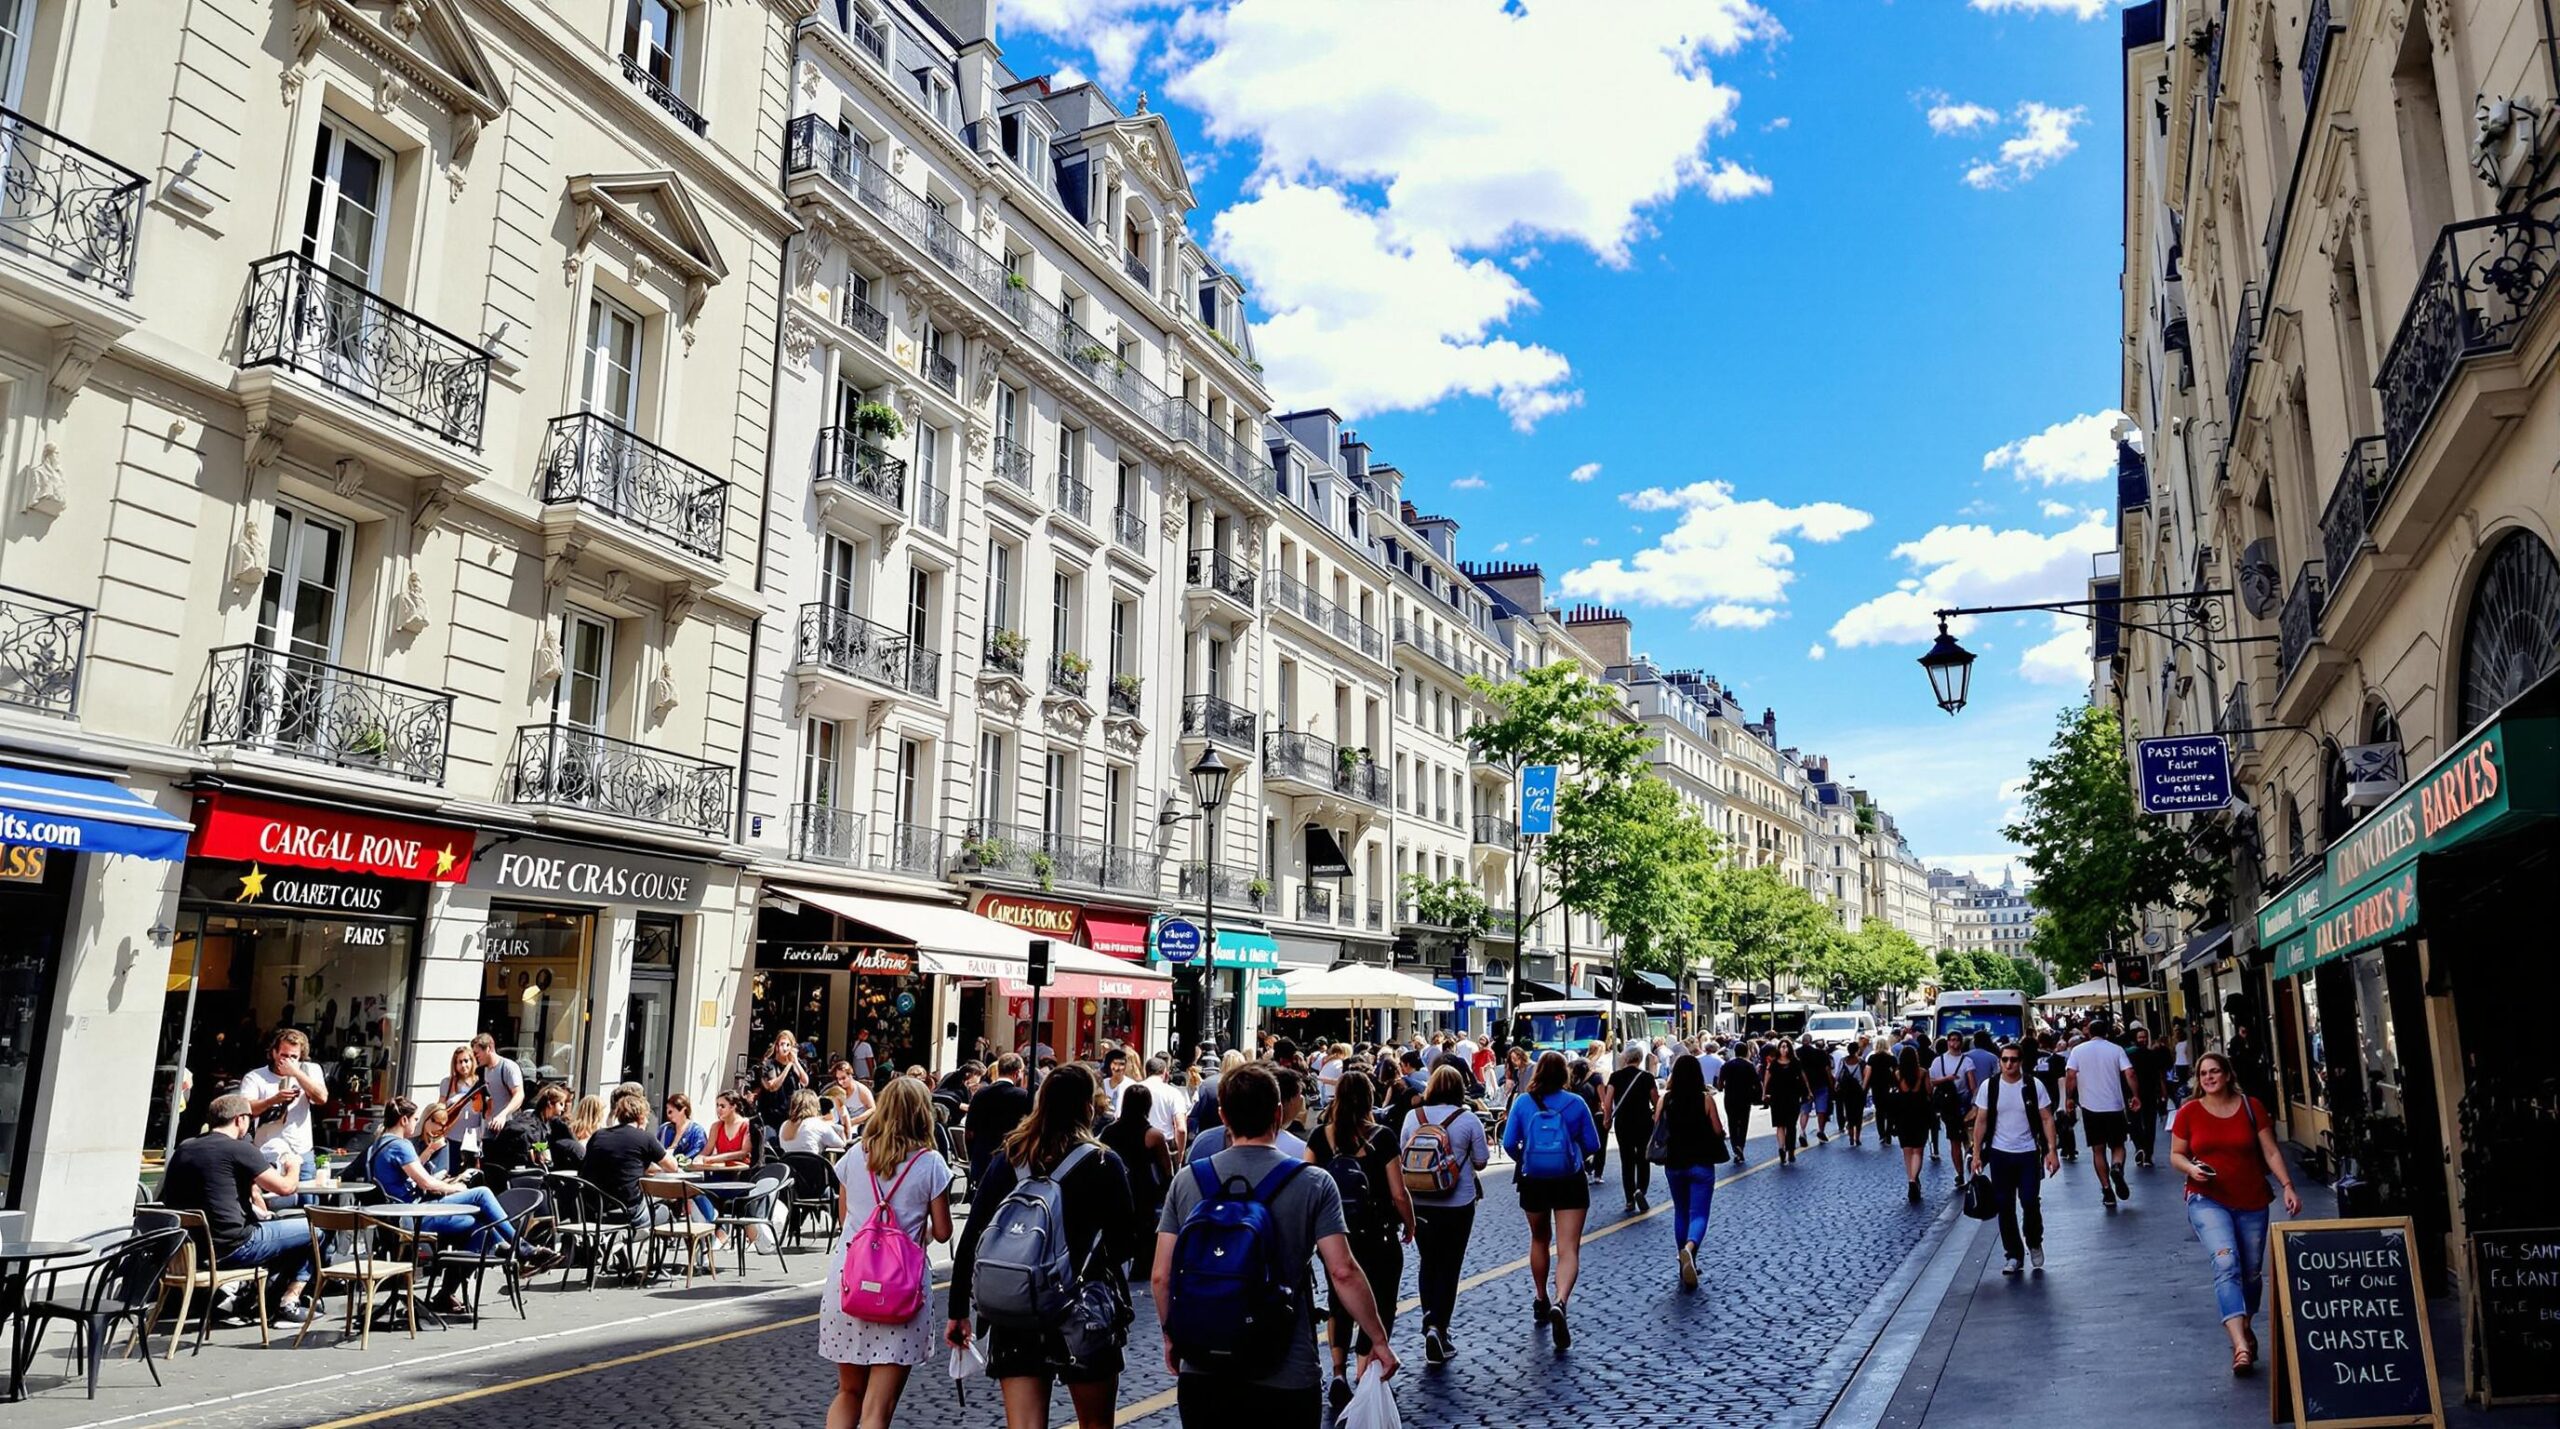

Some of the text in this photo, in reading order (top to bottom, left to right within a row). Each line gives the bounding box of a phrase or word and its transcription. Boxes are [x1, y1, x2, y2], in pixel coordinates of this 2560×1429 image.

[260, 822, 422, 869] CARGAL RONE
[497, 853, 690, 901] FORE CRAS COUSE
[2301, 1298, 2404, 1319] CUFPRATE
[2308, 1329, 2409, 1351] CHASTER
[2333, 1362, 2401, 1385] DIALE
